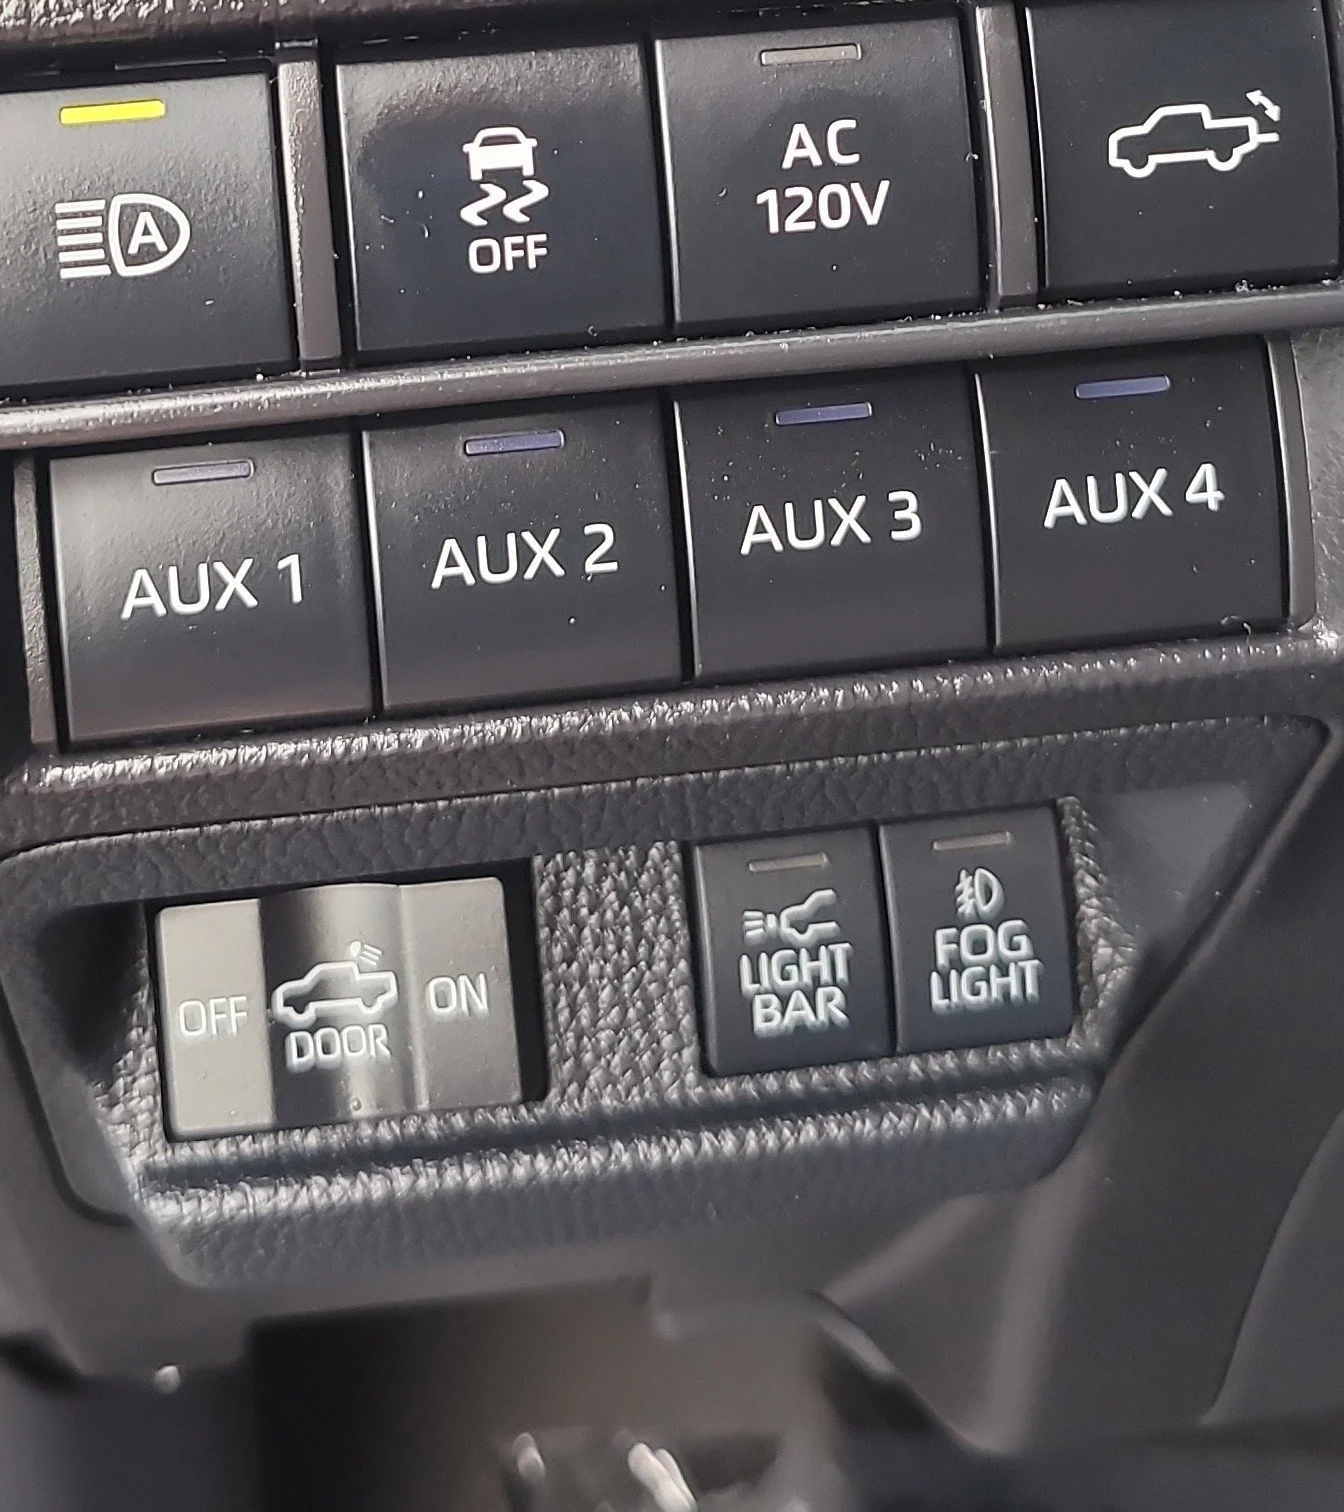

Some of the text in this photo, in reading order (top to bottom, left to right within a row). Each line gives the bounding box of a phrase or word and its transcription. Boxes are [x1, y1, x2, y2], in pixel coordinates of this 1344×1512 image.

[781, 119, 860, 169] AC
[756, 180, 891, 234] 120V
[468, 233, 549, 275] OFF
[1043, 462, 1225, 529] AUX 4
[739, 490, 923, 556] AUX 3
[430, 523, 619, 589] AUX 2
[120, 553, 306, 620] AUX 1
[739, 942, 853, 995] LIGHT
[935, 919, 1035, 970] FOG
[426, 972, 489, 1017] ON
[753, 986, 850, 1036] BAR
[930, 958, 1044, 1014] LIGHT
[179, 995, 249, 1037] OFF
[286, 1023, 392, 1072] DOOR
